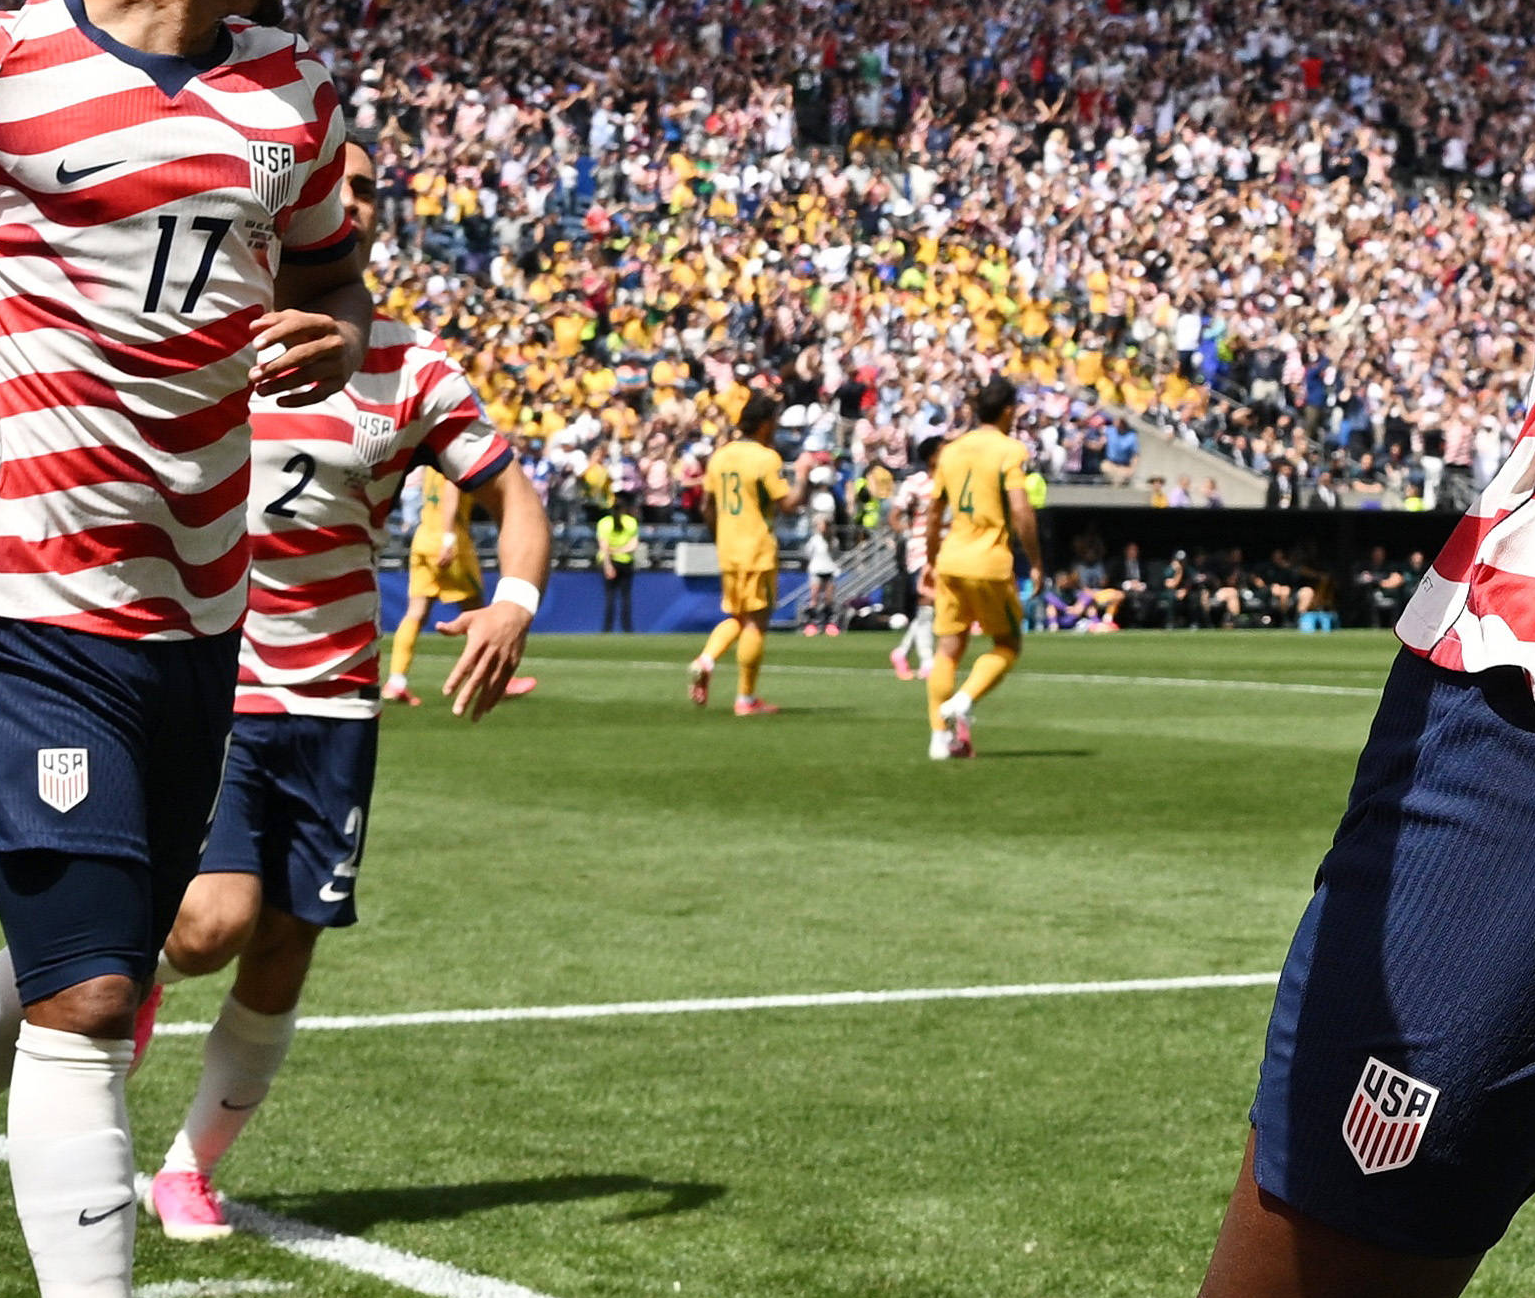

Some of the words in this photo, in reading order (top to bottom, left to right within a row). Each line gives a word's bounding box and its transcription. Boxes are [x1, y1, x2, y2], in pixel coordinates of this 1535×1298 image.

[252, 145, 292, 173] USA
[144, 214, 233, 314] 17
[358, 415, 391, 437] USA
[264, 453, 315, 519] 2
[721, 471, 743, 516] 13
[959, 468, 974, 516] 4
[43, 753, 82, 775] USA
[1363, 1063, 1432, 1118] USA
